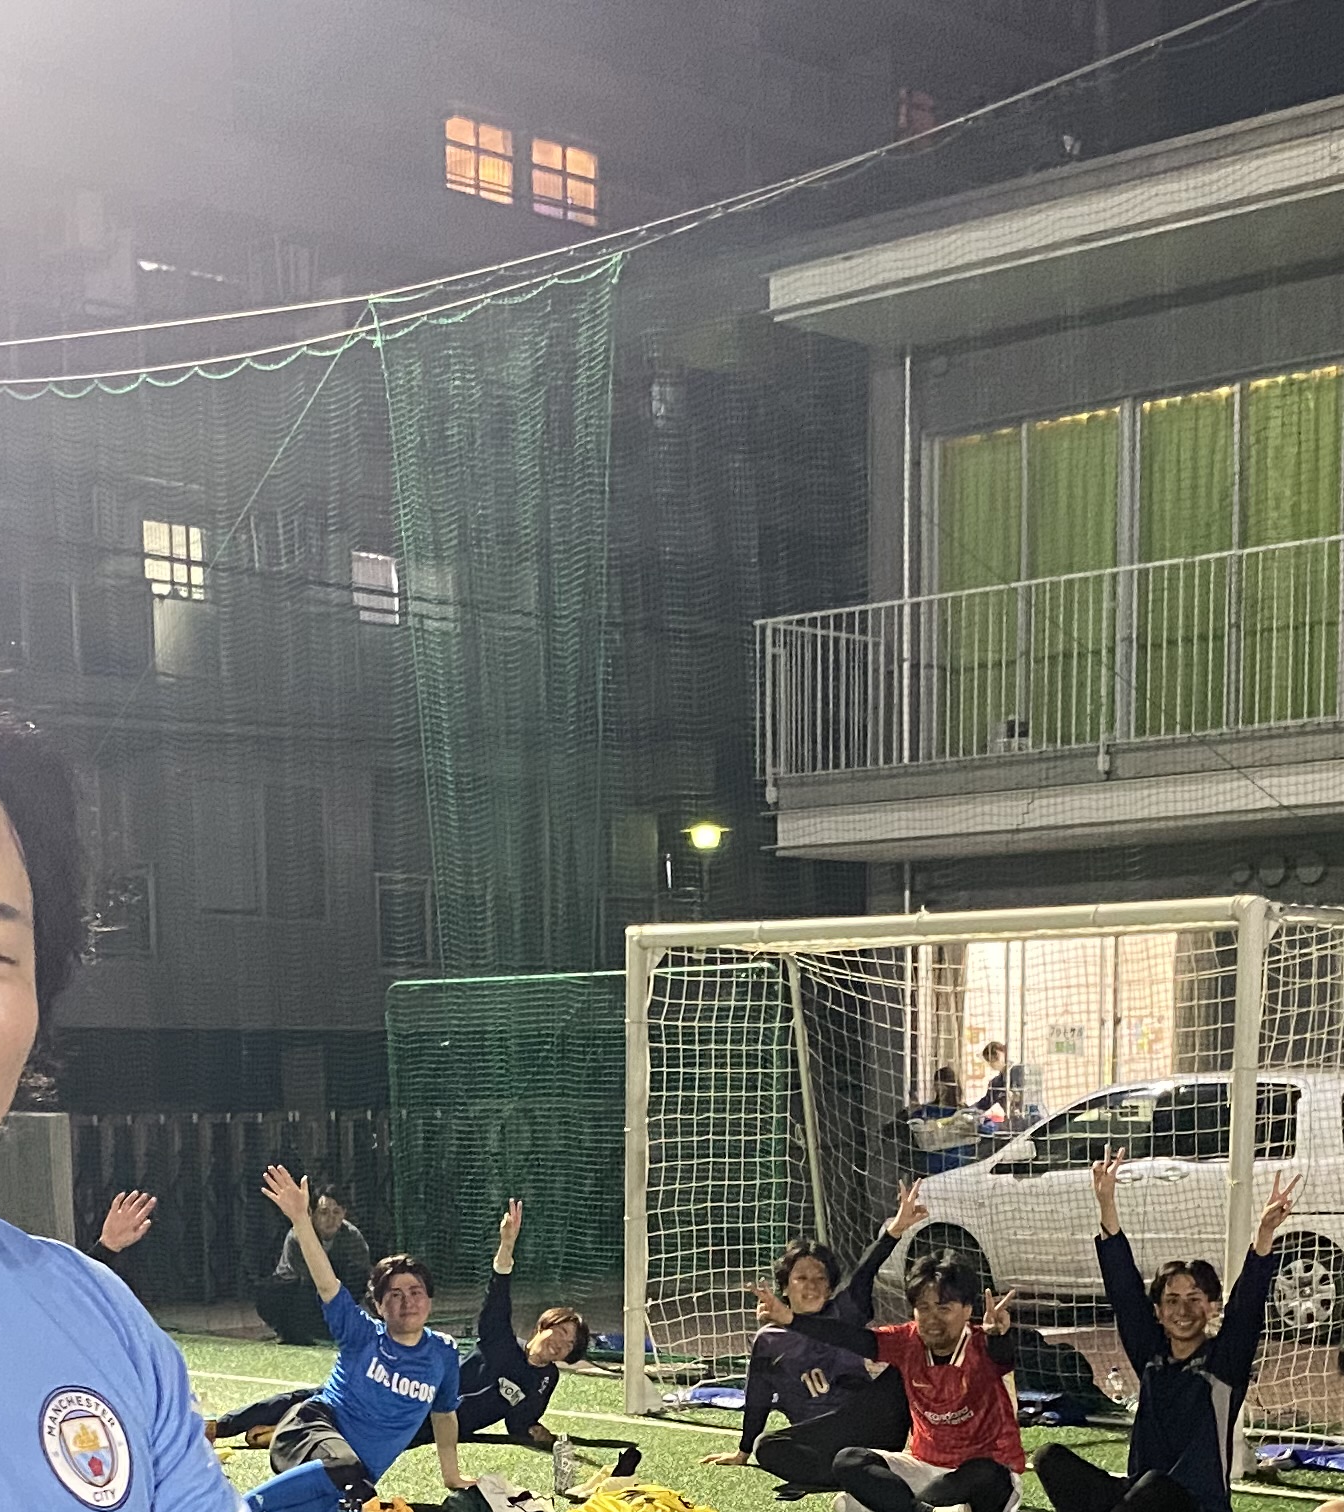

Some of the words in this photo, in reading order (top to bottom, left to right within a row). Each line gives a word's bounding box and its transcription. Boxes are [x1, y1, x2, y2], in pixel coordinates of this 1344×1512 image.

[391, 1371, 437, 1404] LOCOS
[800, 1367, 831, 1398] 10
[46, 1395, 117, 1438] MANCHESTER
[92, 1488, 117, 1503] CITY
